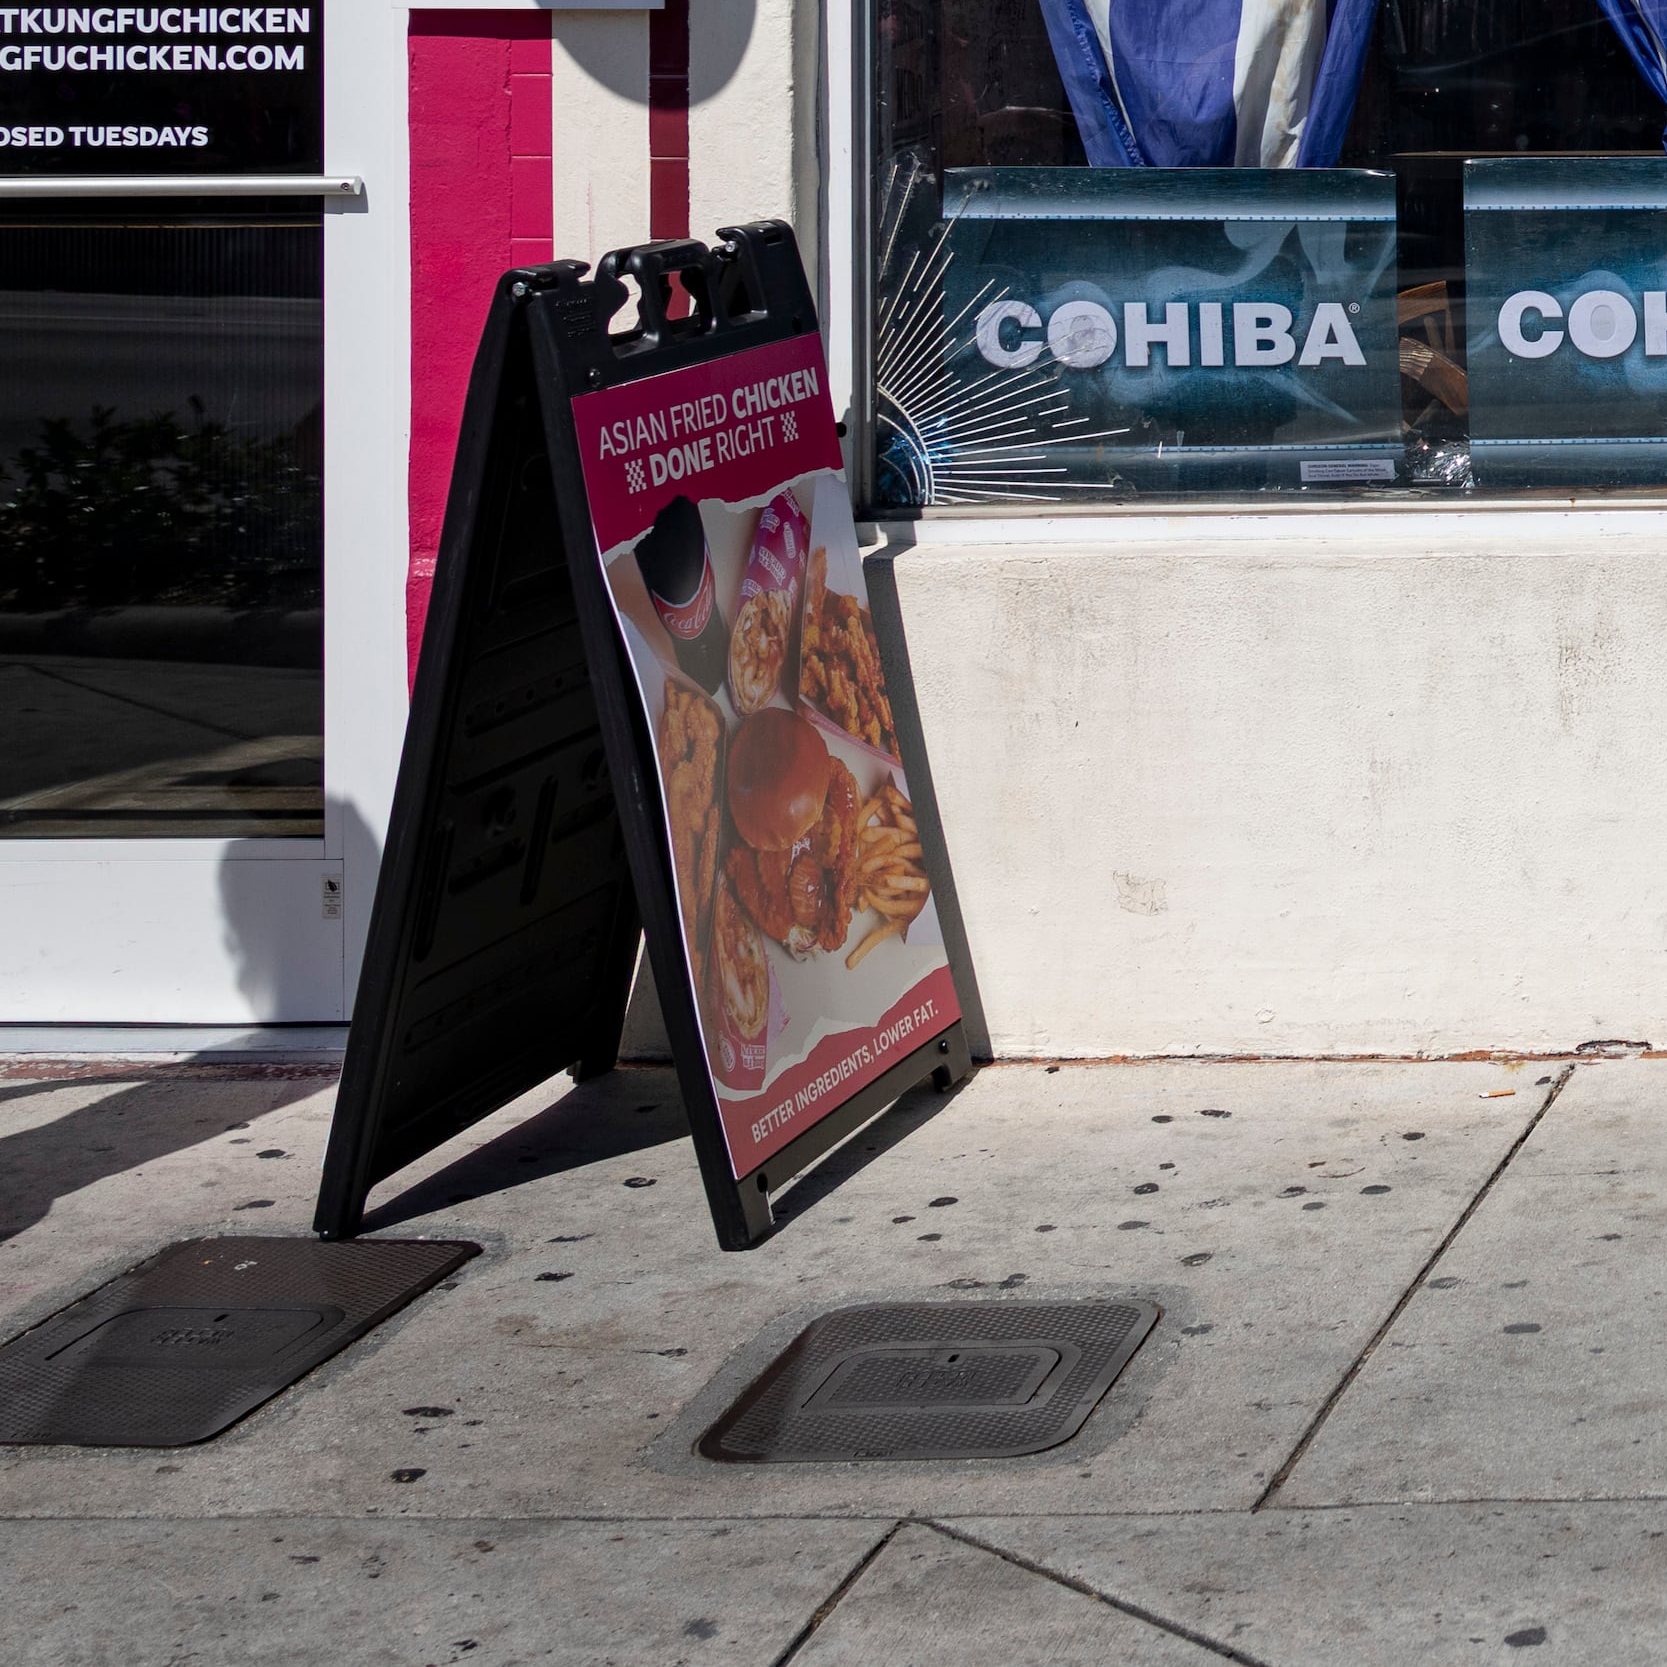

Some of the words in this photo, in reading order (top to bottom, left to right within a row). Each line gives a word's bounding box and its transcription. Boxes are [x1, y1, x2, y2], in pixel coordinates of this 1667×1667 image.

[69, 126, 209, 147] TUESDAYS
[600, 410, 667, 460] ASIAN
[669, 393, 728, 439] FRIED
[731, 366, 820, 419] CHICKEN
[649, 437, 715, 487] DONE
[717, 415, 776, 464] RIGHT
[751, 1099, 797, 1144] BETTER
[795, 1045, 876, 1112] INGREDIENTS,
[872, 1014, 914, 1056] LOWER
[912, 999, 940, 1028] FAT.
